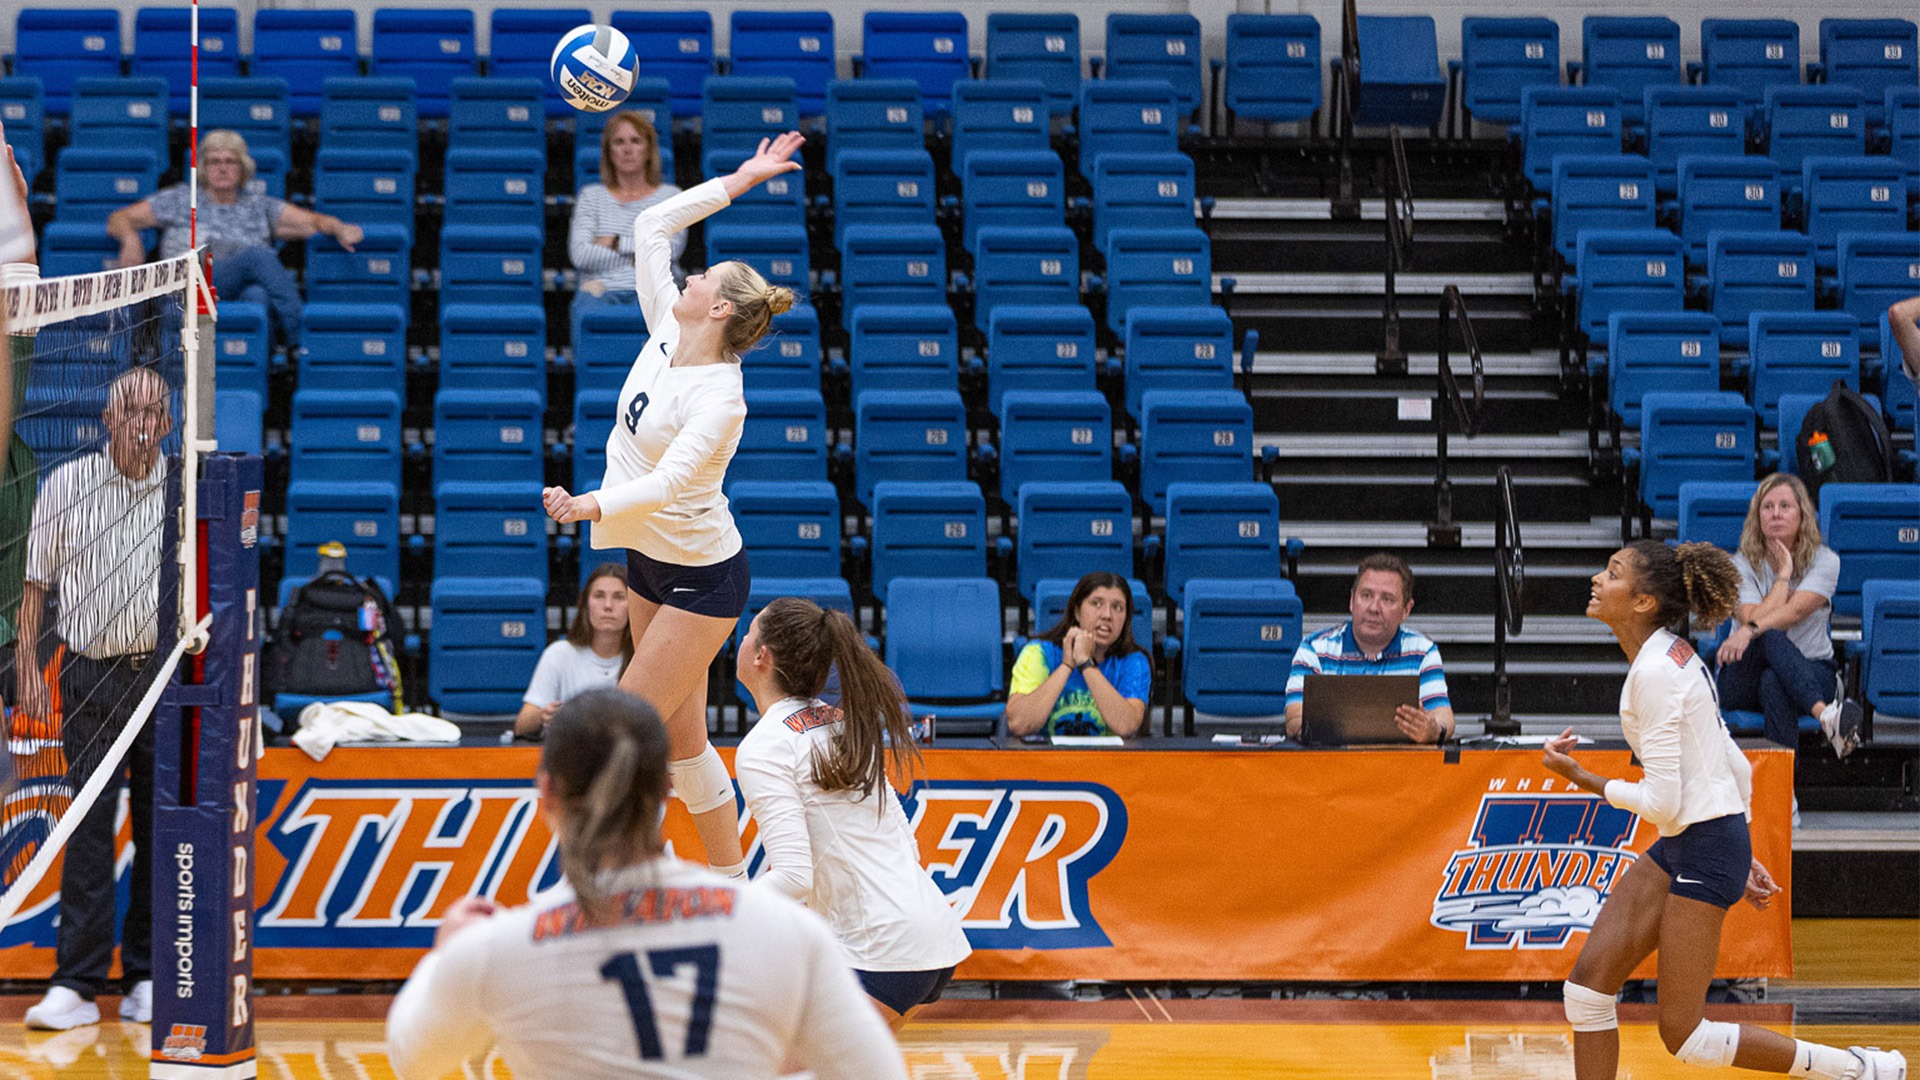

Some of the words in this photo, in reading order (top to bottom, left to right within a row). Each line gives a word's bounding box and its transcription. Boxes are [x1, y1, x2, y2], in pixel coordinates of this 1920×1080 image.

[1528, 44, 1542, 58] 36
[1649, 45, 1662, 59] 37
[1769, 44, 1781, 59] 38
[1887, 45, 1900, 59] 39
[577, 70, 618, 99] NCAA
[567, 78, 609, 108] molten
[1590, 113, 1603, 127] 29
[1712, 113, 1726, 127] 30
[1833, 114, 1846, 128] 31
[1622, 185, 1636, 199] 29
[1748, 186, 1762, 200] 30
[1874, 188, 1887, 201] 31
[1044, 261, 1059, 275] 27
[1176, 260, 1191, 274] 28
[1650, 263, 1664, 277] 29
[1781, 263, 1795, 277] 30
[1059, 344, 1075, 358] 27
[1198, 344, 1213, 359] 28
[1684, 342, 1699, 357] 29
[1824, 343, 1839, 357] 30
[625, 392, 649, 436] 9
[789, 427, 805, 442] 25
[929, 431, 946, 444] 26
[1075, 429, 1090, 444] 27
[1217, 432, 1232, 446] 28
[1719, 434, 1734, 448] 29
[801, 525, 819, 539] 25
[947, 524, 964, 538] 26
[1094, 521, 1111, 536] 27
[1242, 522, 1258, 537] 28
[1901, 529, 1918, 543] 30
[504, 623, 524, 637] 23
[1264, 626, 1280, 641] 28
[1488, 778, 1579, 792] WHEA
[258, 786, 1109, 930] THER
[174, 842, 196, 911] sports
[532, 886, 738, 943] WATON
[174, 914, 196, 998] imports
[600, 943, 720, 1061] 17
